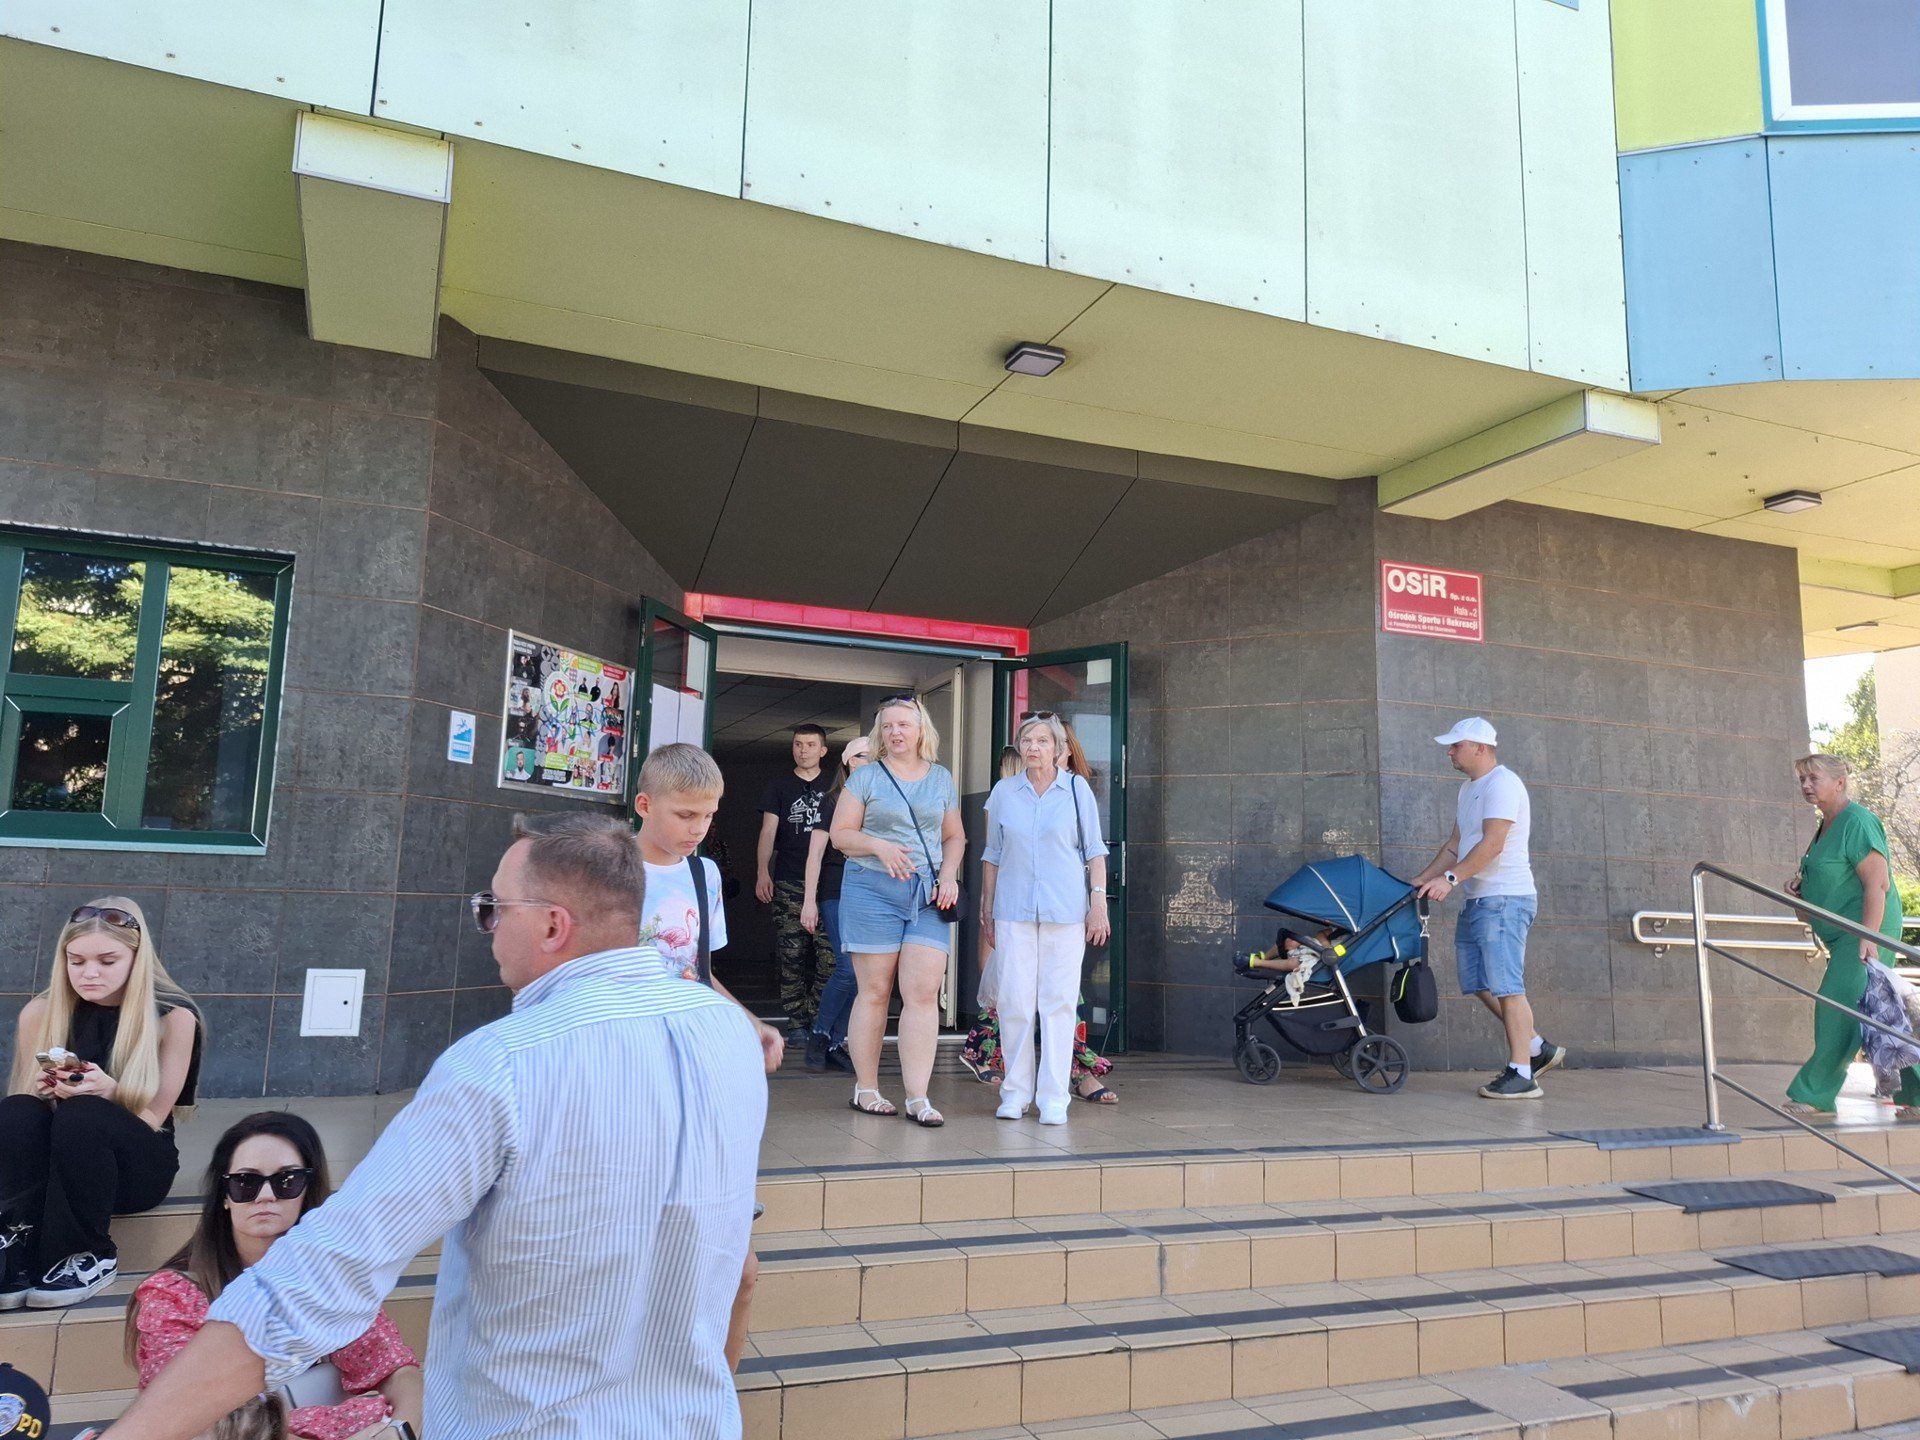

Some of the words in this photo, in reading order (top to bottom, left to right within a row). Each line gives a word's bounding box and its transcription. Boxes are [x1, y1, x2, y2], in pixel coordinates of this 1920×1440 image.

[1387, 569, 1447, 599] OSiR
[1388, 611, 1417, 621] Ośrodek
[1418, 615, 1441, 625] Sportu
[1447, 618, 1478, 630] Rekreacji
